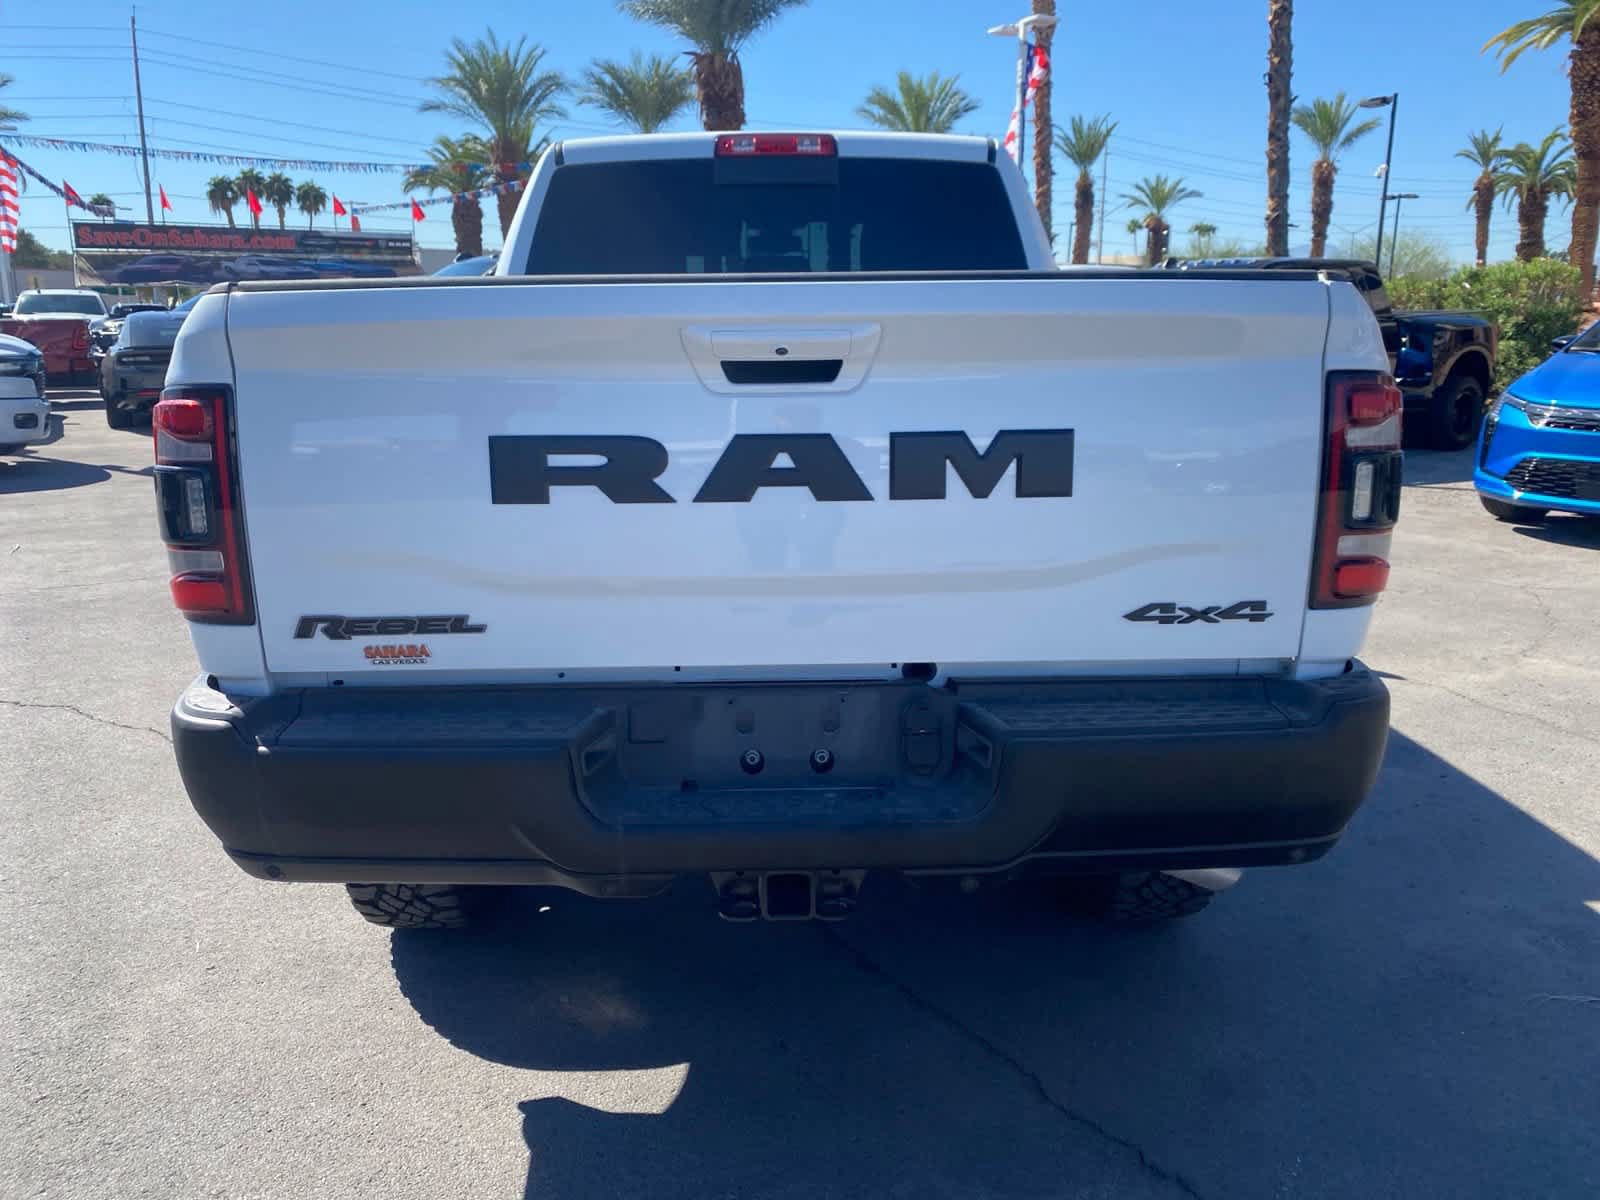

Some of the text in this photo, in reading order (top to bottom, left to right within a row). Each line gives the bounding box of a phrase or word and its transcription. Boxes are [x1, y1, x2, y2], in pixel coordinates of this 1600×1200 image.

[488, 428, 1075, 504] RAM
[1122, 600, 1274, 624] 4x4
[293, 614, 488, 640] REBEL
